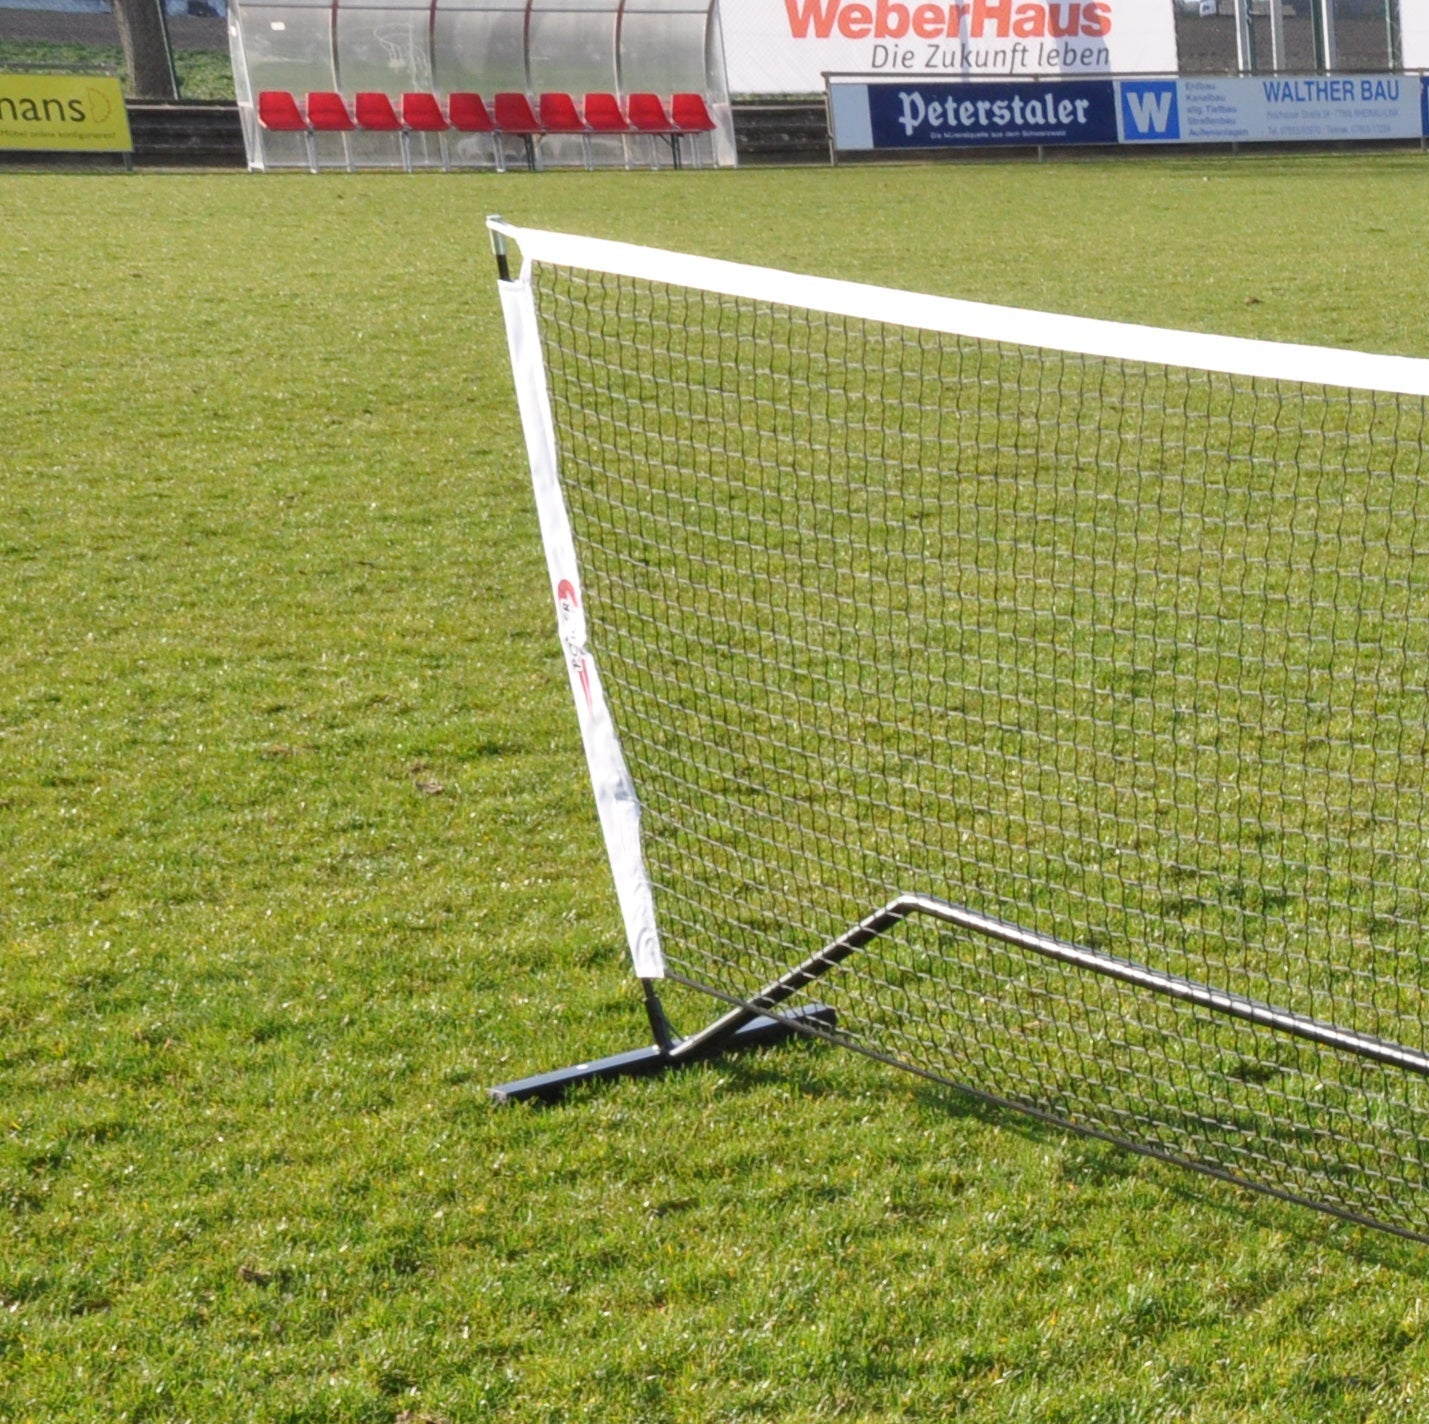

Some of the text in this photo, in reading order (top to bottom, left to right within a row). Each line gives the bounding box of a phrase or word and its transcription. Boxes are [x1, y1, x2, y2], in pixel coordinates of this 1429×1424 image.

[784, 0, 1112, 39] WeberHaus
[871, 42, 1110, 75] Die Zukunft leben
[1263, 79, 1400, 102] WALTHER BAU
[898, 90, 1090, 137] Peterstaler
[1126, 91, 1173, 133] W
